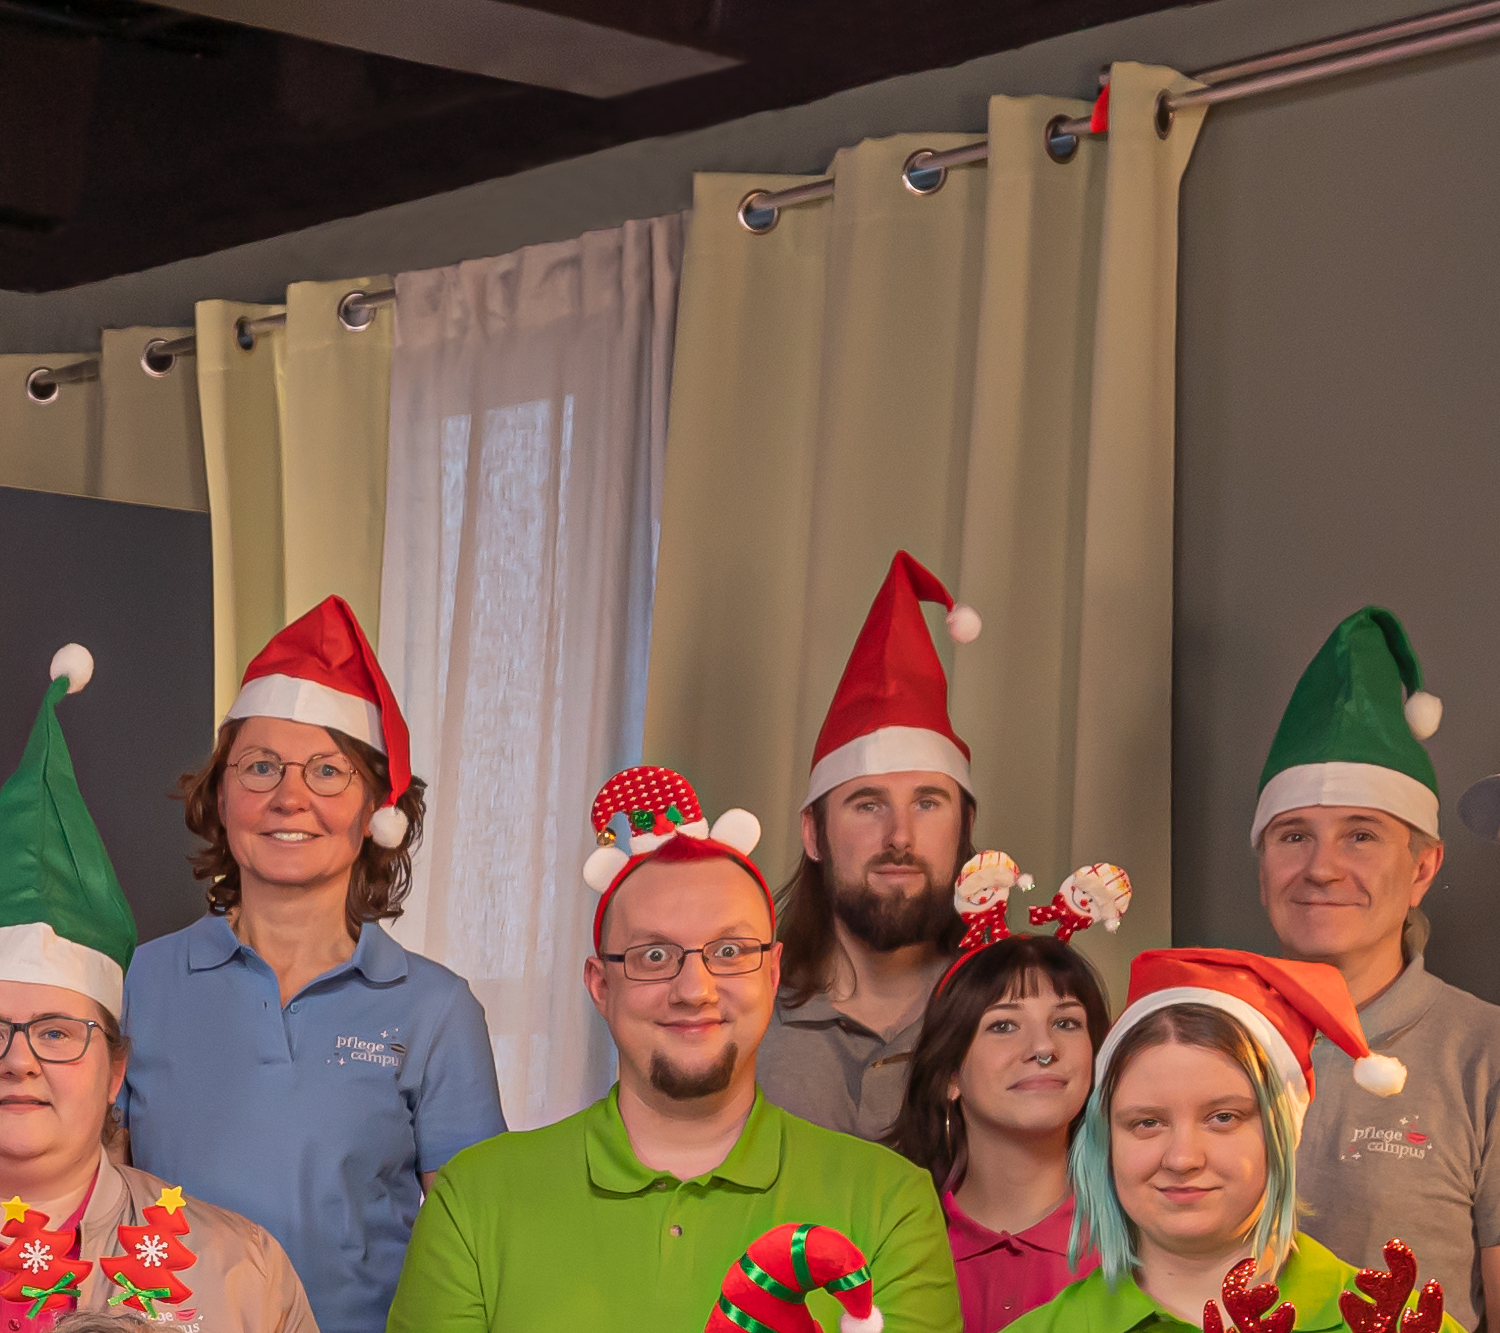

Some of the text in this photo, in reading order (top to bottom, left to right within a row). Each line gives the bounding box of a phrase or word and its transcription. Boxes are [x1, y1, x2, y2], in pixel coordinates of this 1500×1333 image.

[335, 1036, 385, 1052] pflege
[350, 1051, 399, 1067] campu
[1350, 1126, 1403, 1144] pflege
[1367, 1141, 1426, 1160] campus
